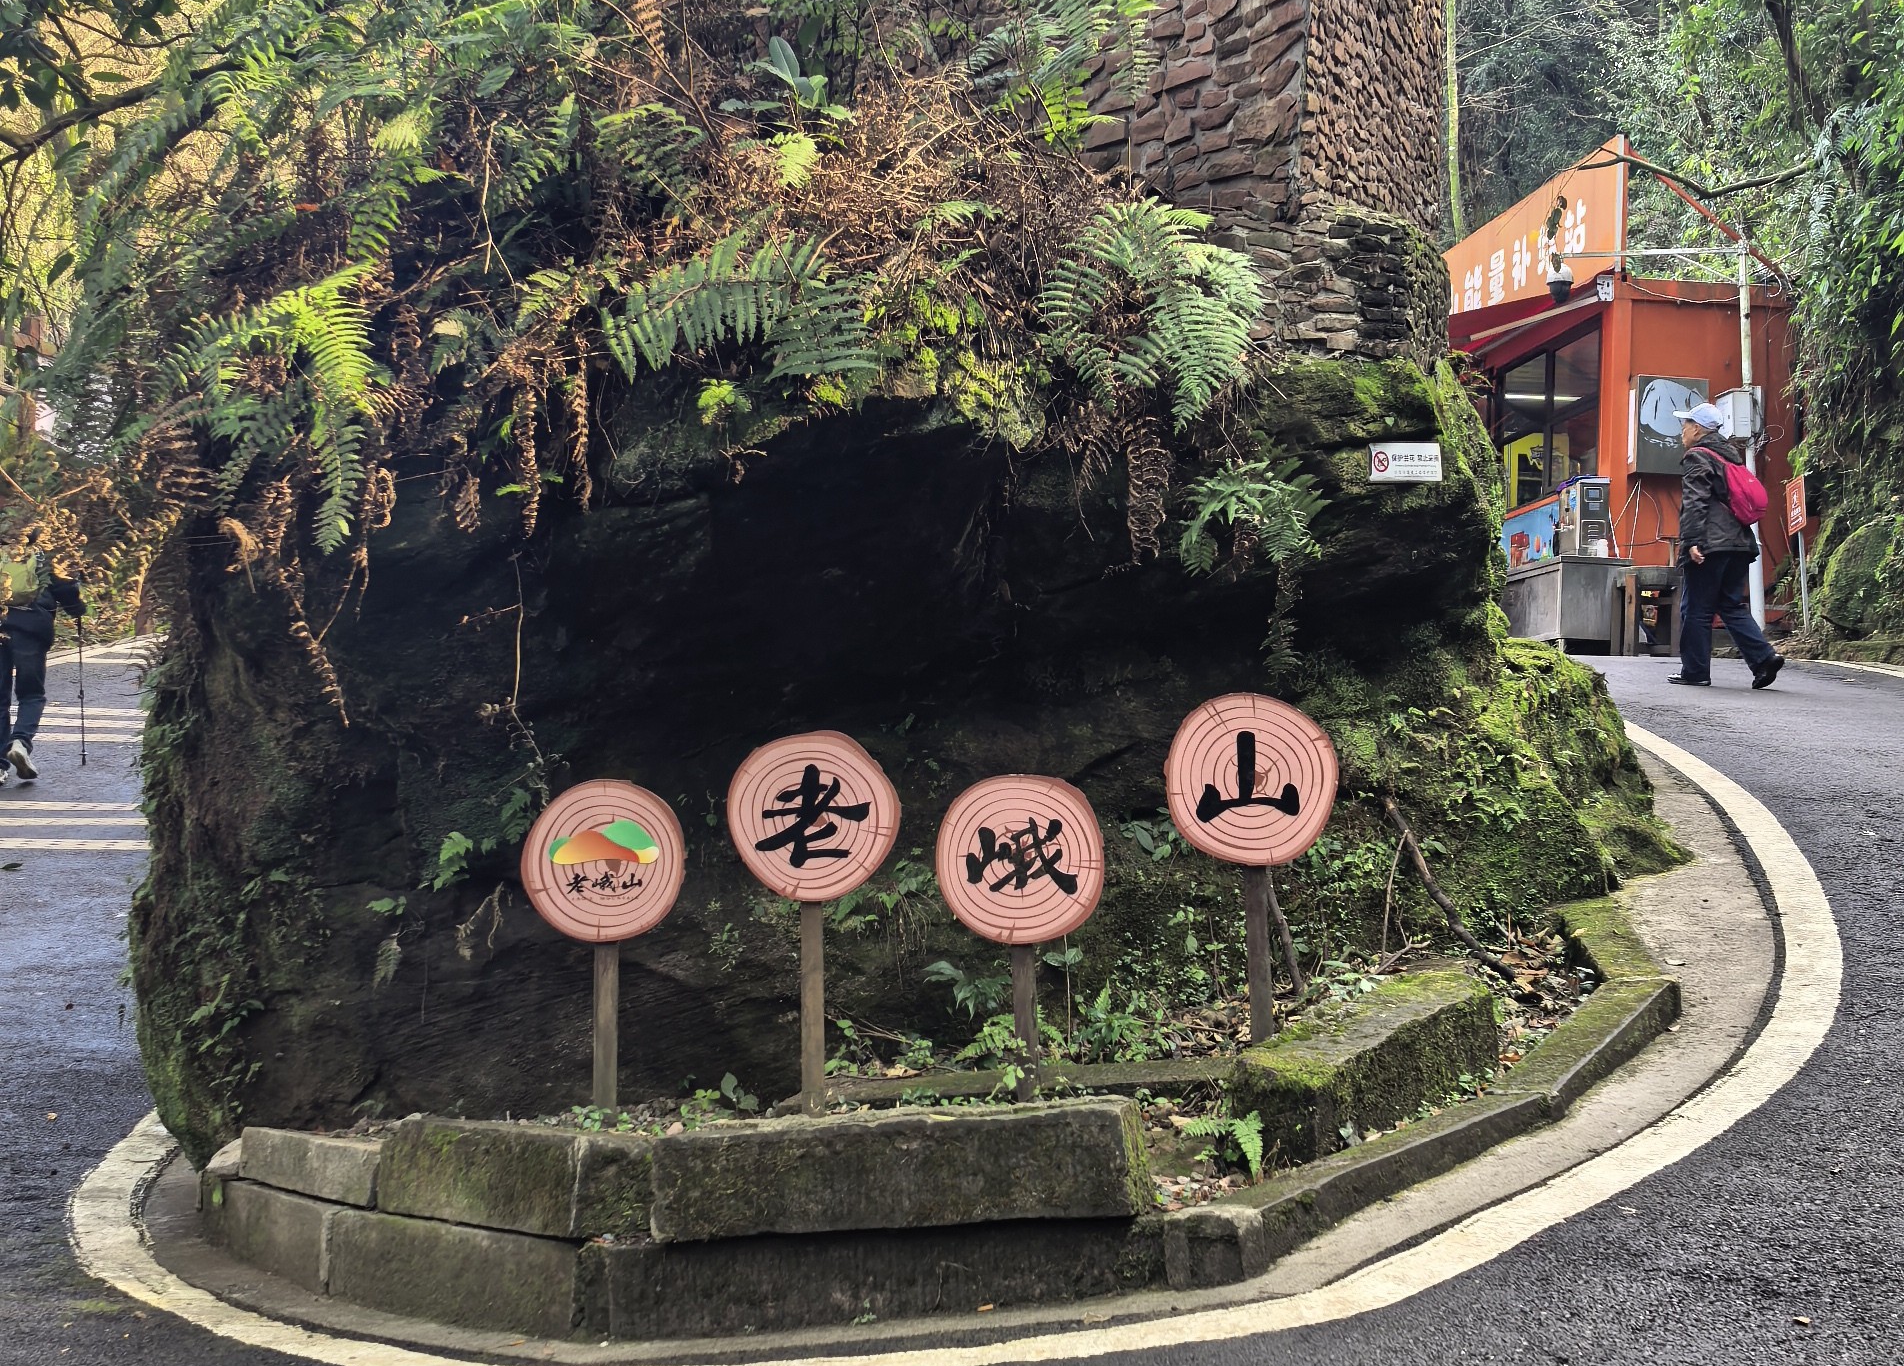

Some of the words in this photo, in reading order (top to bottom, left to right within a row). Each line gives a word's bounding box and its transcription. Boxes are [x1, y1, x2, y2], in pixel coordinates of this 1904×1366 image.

[755, 763, 870, 867] 老
[1196, 731, 1300, 823] 山
[566, 871, 642, 895] 老峨山
[966, 817, 1077, 894] 峨
